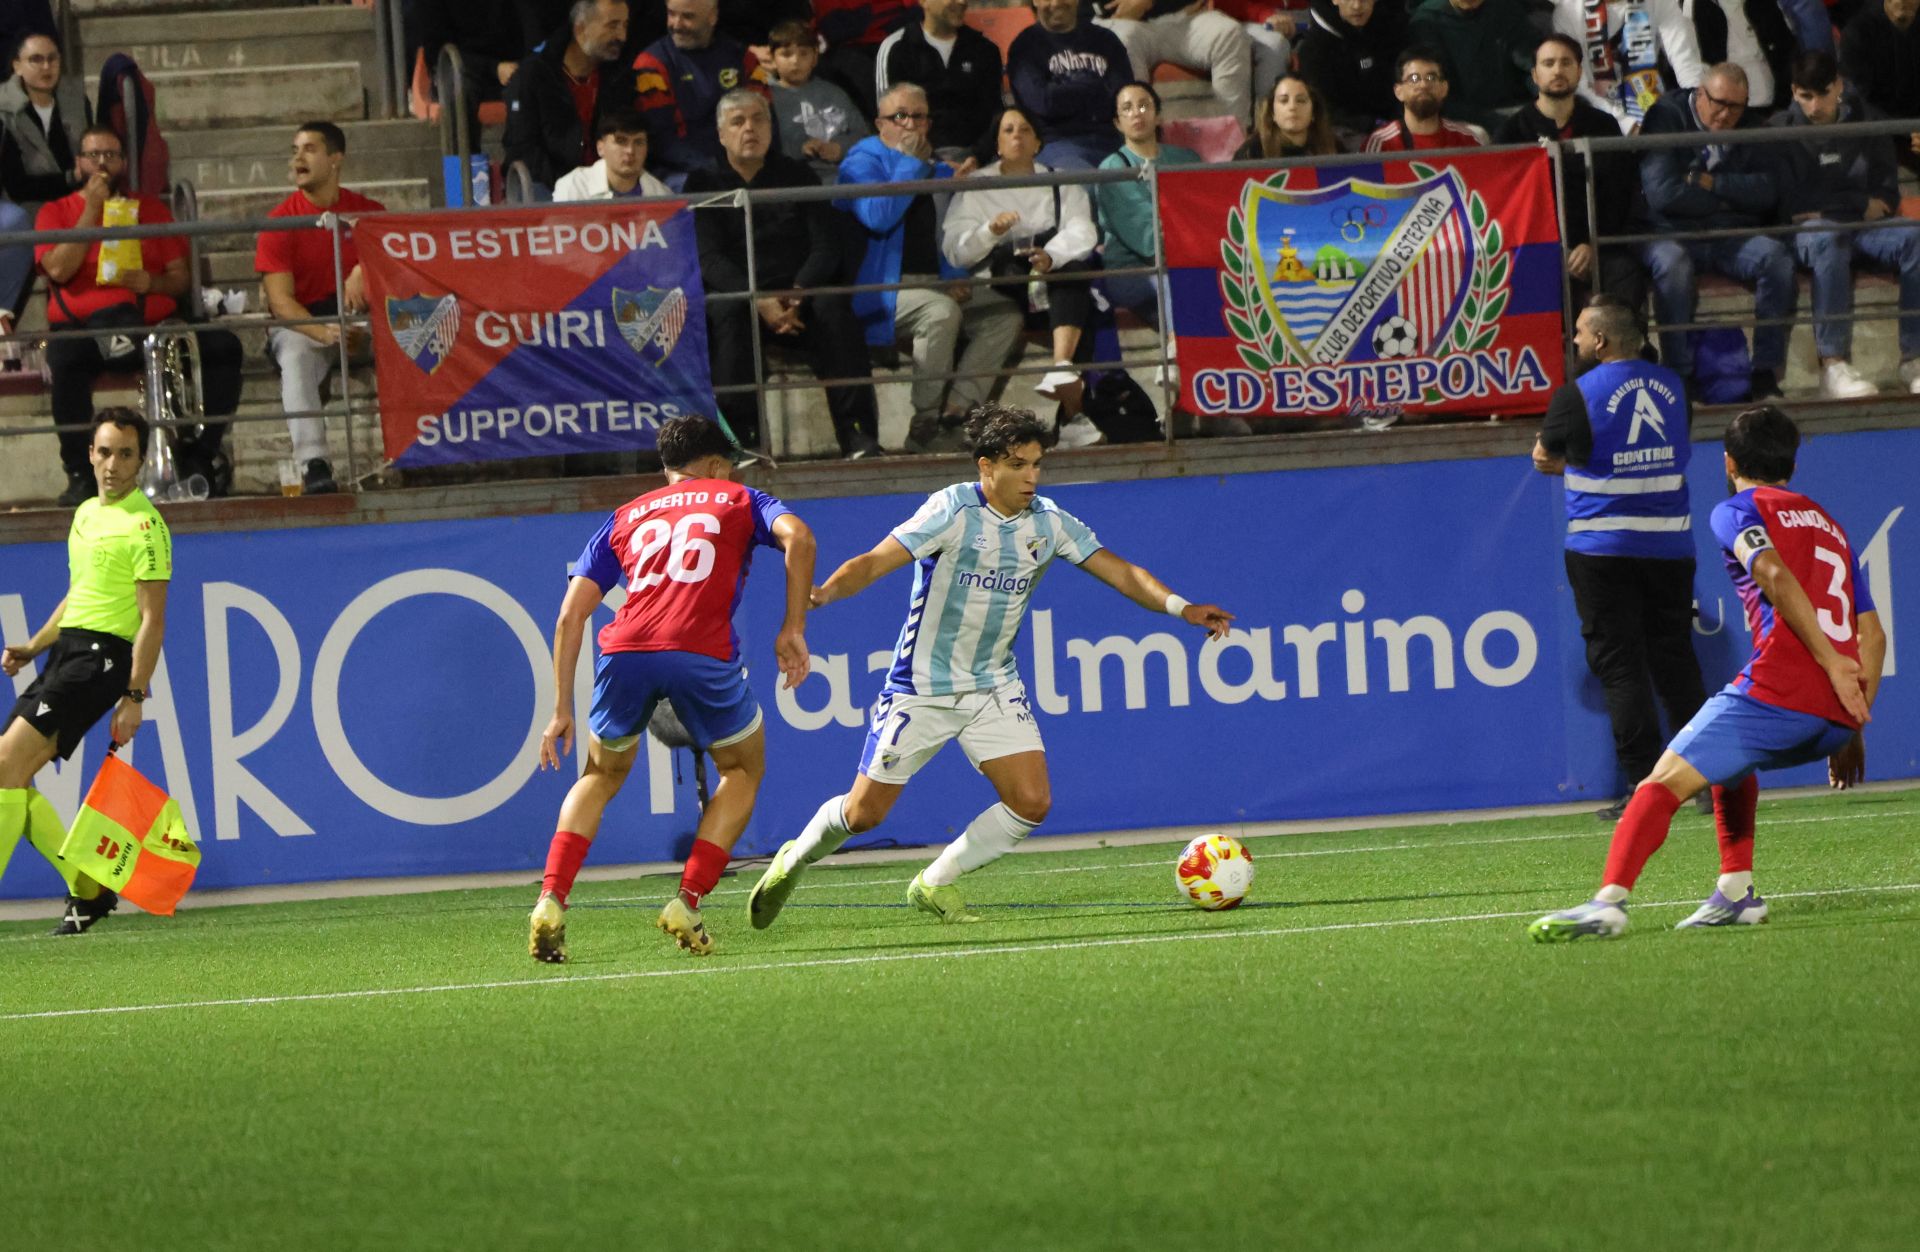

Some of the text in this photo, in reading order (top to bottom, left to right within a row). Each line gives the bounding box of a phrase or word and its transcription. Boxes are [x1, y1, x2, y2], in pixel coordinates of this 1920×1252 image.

[382, 220, 668, 261] CD ESTEPONA
[1316, 195, 1445, 365] CLUB DEPORTIVO ESTEPONA
[475, 309, 607, 350] GUIRI
[1194, 346, 1551, 415] CD ESTEPONA
[416, 400, 681, 446] SUPPORTERS
[1612, 445, 1676, 466] CONTROL
[628, 491, 734, 524] ALBERTO G.
[628, 513, 721, 593] 26
[1743, 529, 1766, 550] C
[1814, 545, 1853, 642] 3
[891, 710, 912, 747] 7
